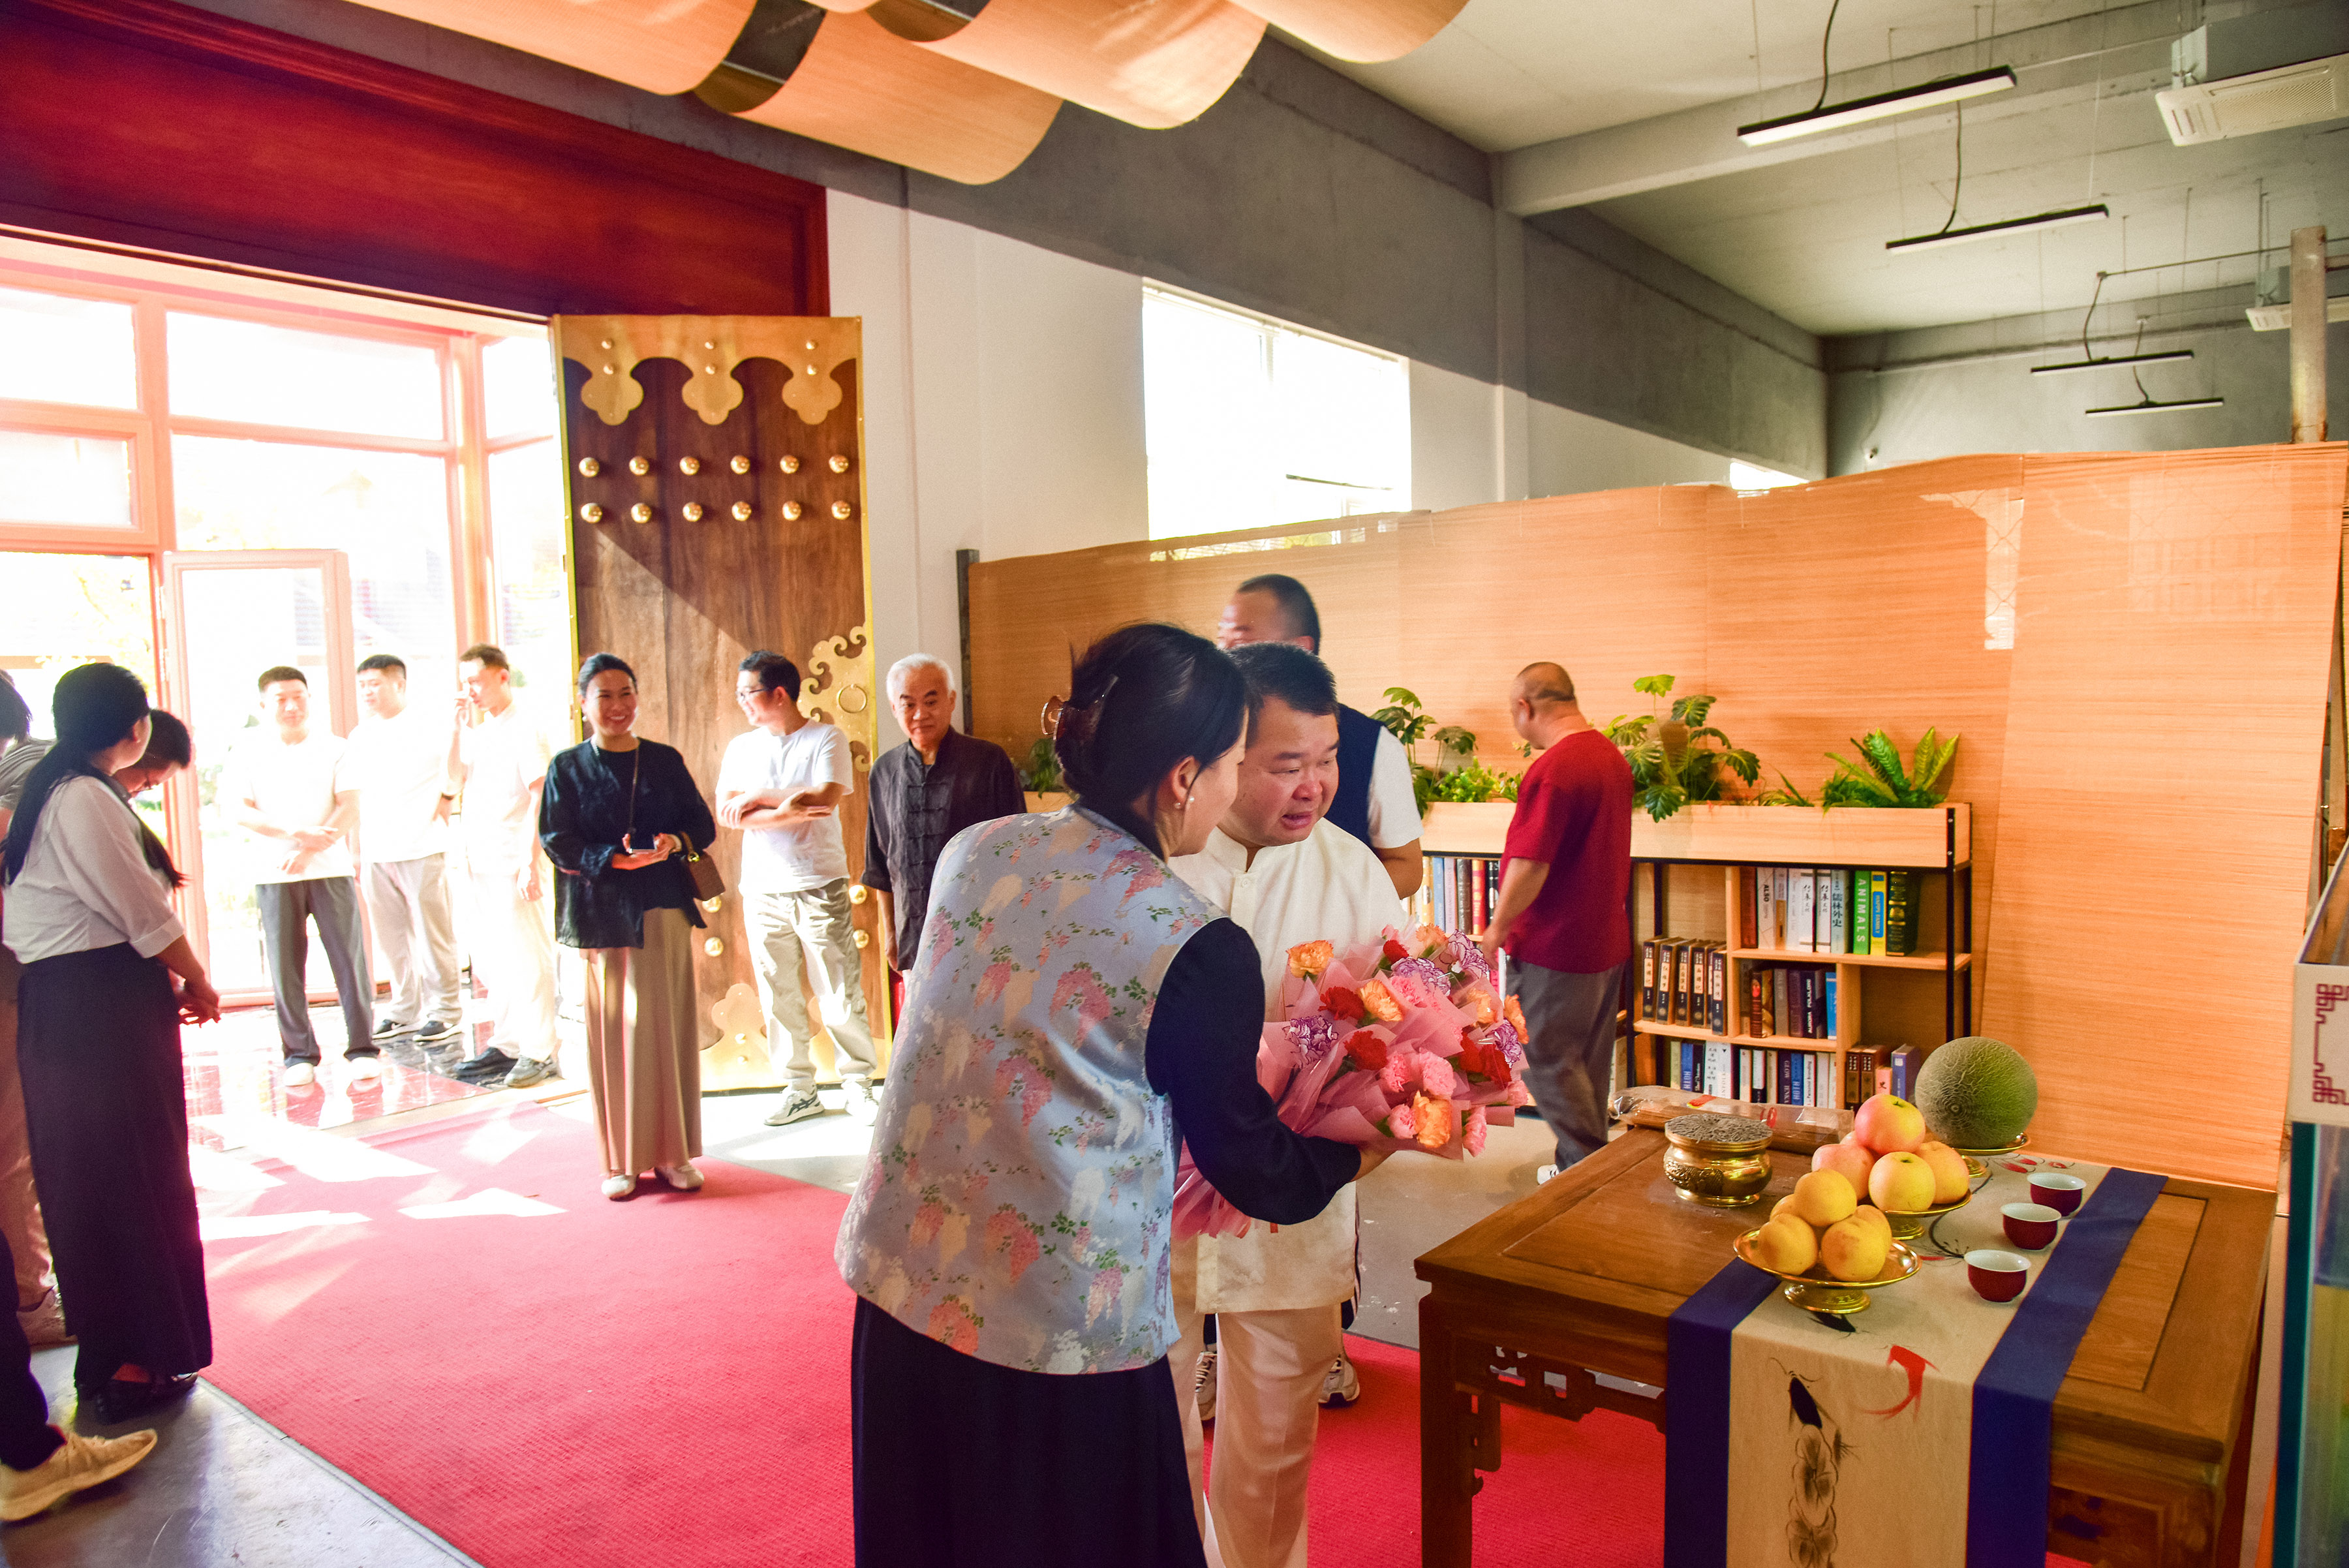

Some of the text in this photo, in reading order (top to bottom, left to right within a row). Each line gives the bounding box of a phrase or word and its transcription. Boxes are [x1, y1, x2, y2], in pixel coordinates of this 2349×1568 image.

[1832, 893, 1842, 927] 儒林外史
[1856, 878, 1867, 942] ANIMALS
